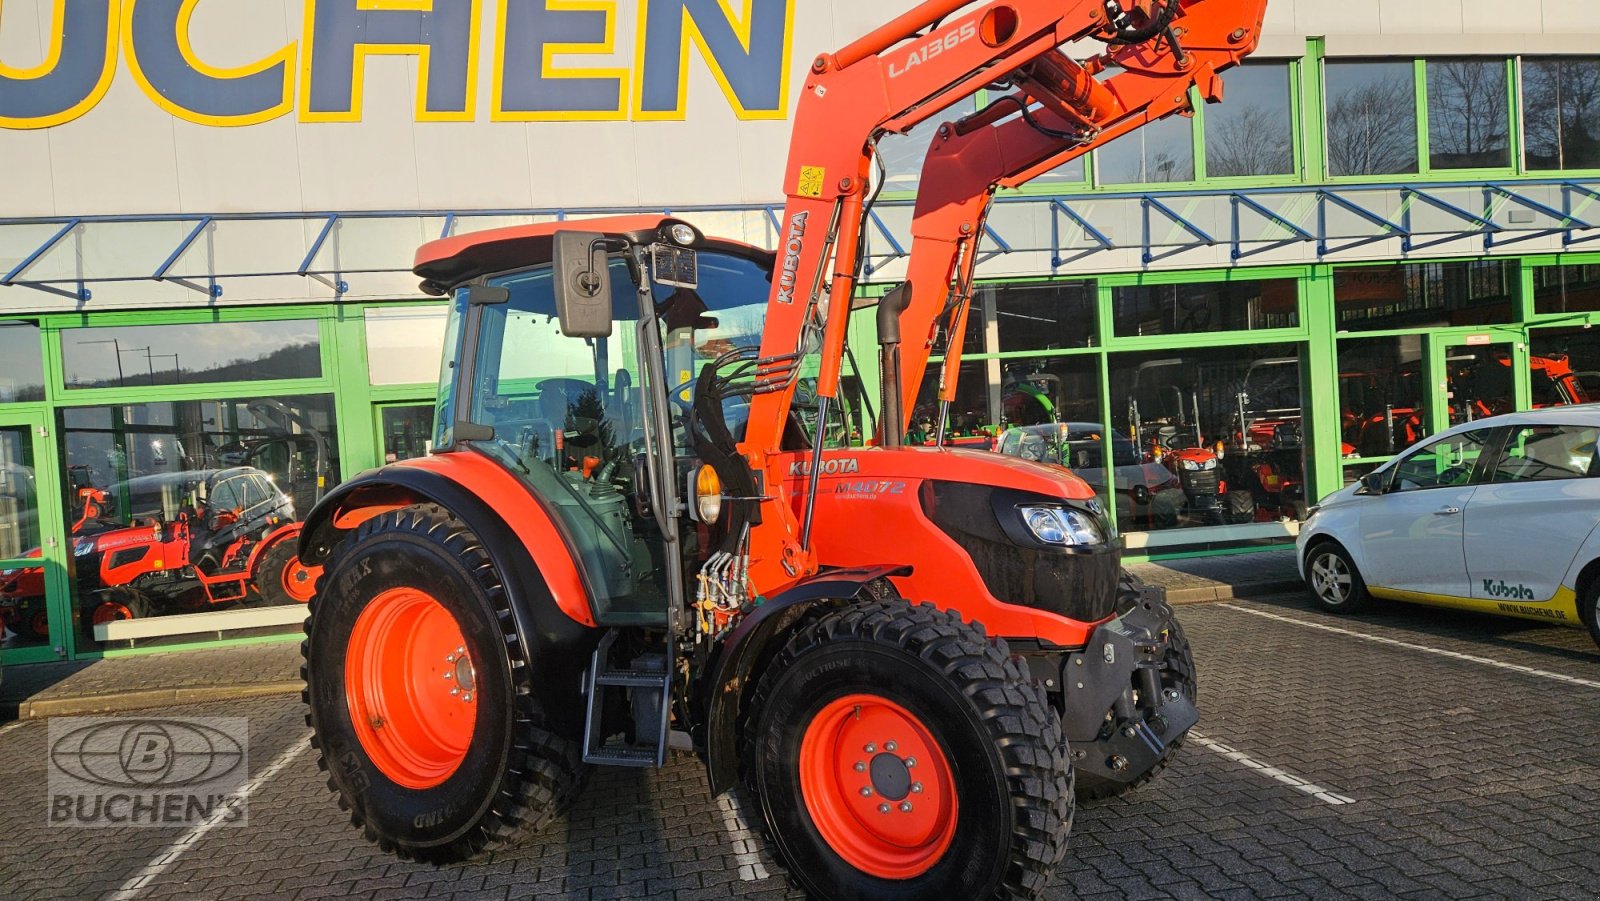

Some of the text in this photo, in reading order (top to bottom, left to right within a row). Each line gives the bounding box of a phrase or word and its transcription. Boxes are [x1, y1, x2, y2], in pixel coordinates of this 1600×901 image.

[888, 20, 976, 79] LA1365
[777, 210, 809, 305] KUBOTA
[788, 458, 859, 476] KUBOTA
[835, 480, 906, 494] M4072
[1483, 578, 1535, 600] Kubota
